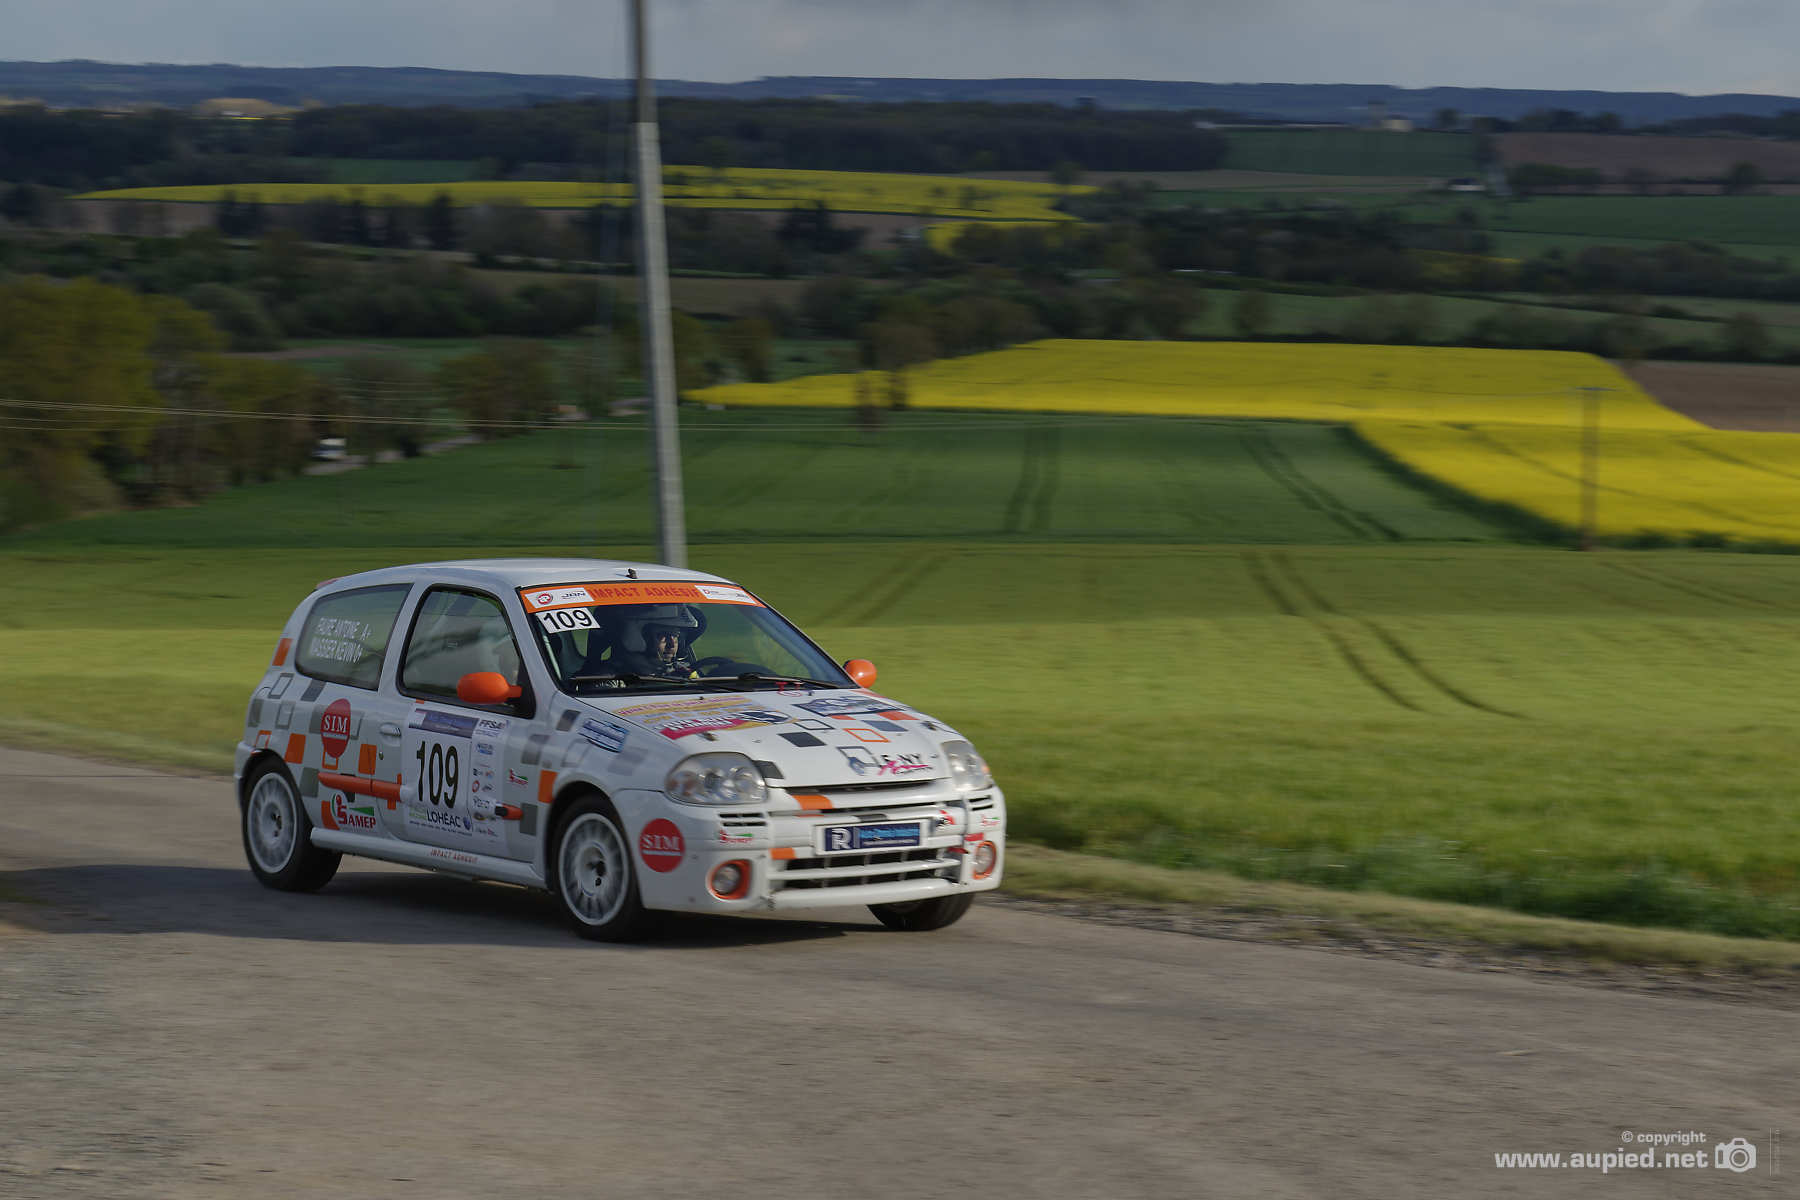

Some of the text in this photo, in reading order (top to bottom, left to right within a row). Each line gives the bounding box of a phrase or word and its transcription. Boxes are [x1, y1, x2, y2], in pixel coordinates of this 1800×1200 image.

[588, 586, 641, 599] IMPACT
[543, 608, 593, 630] 109
[323, 714, 349, 733] SIM
[416, 741, 459, 809] 109
[337, 804, 377, 829] SAMEP
[641, 834, 681, 851] SIM
